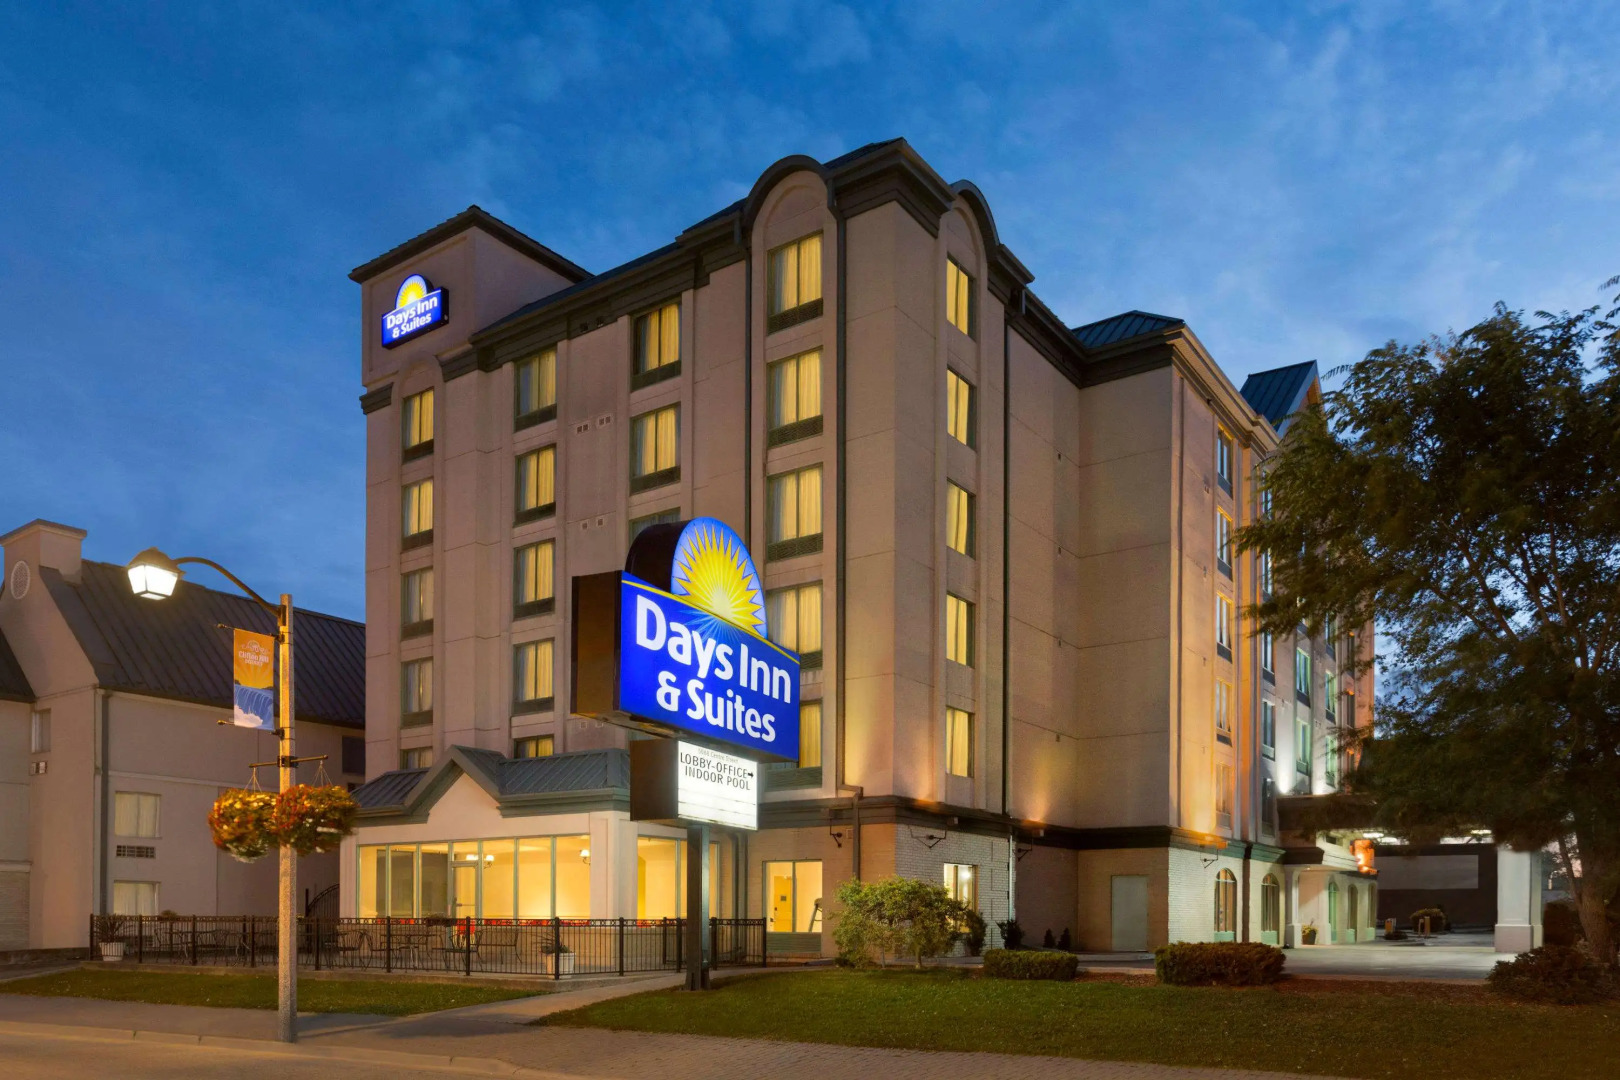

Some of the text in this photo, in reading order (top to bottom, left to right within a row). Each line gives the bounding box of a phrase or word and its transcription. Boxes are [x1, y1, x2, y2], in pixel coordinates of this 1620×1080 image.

[386, 296, 438, 329] Days Inn
[392, 313, 432, 338] & Suites
[635, 594, 791, 704] Days Inn
[656, 670, 776, 743] & Suites
[685, 765, 751, 791] INDOOR POOL
